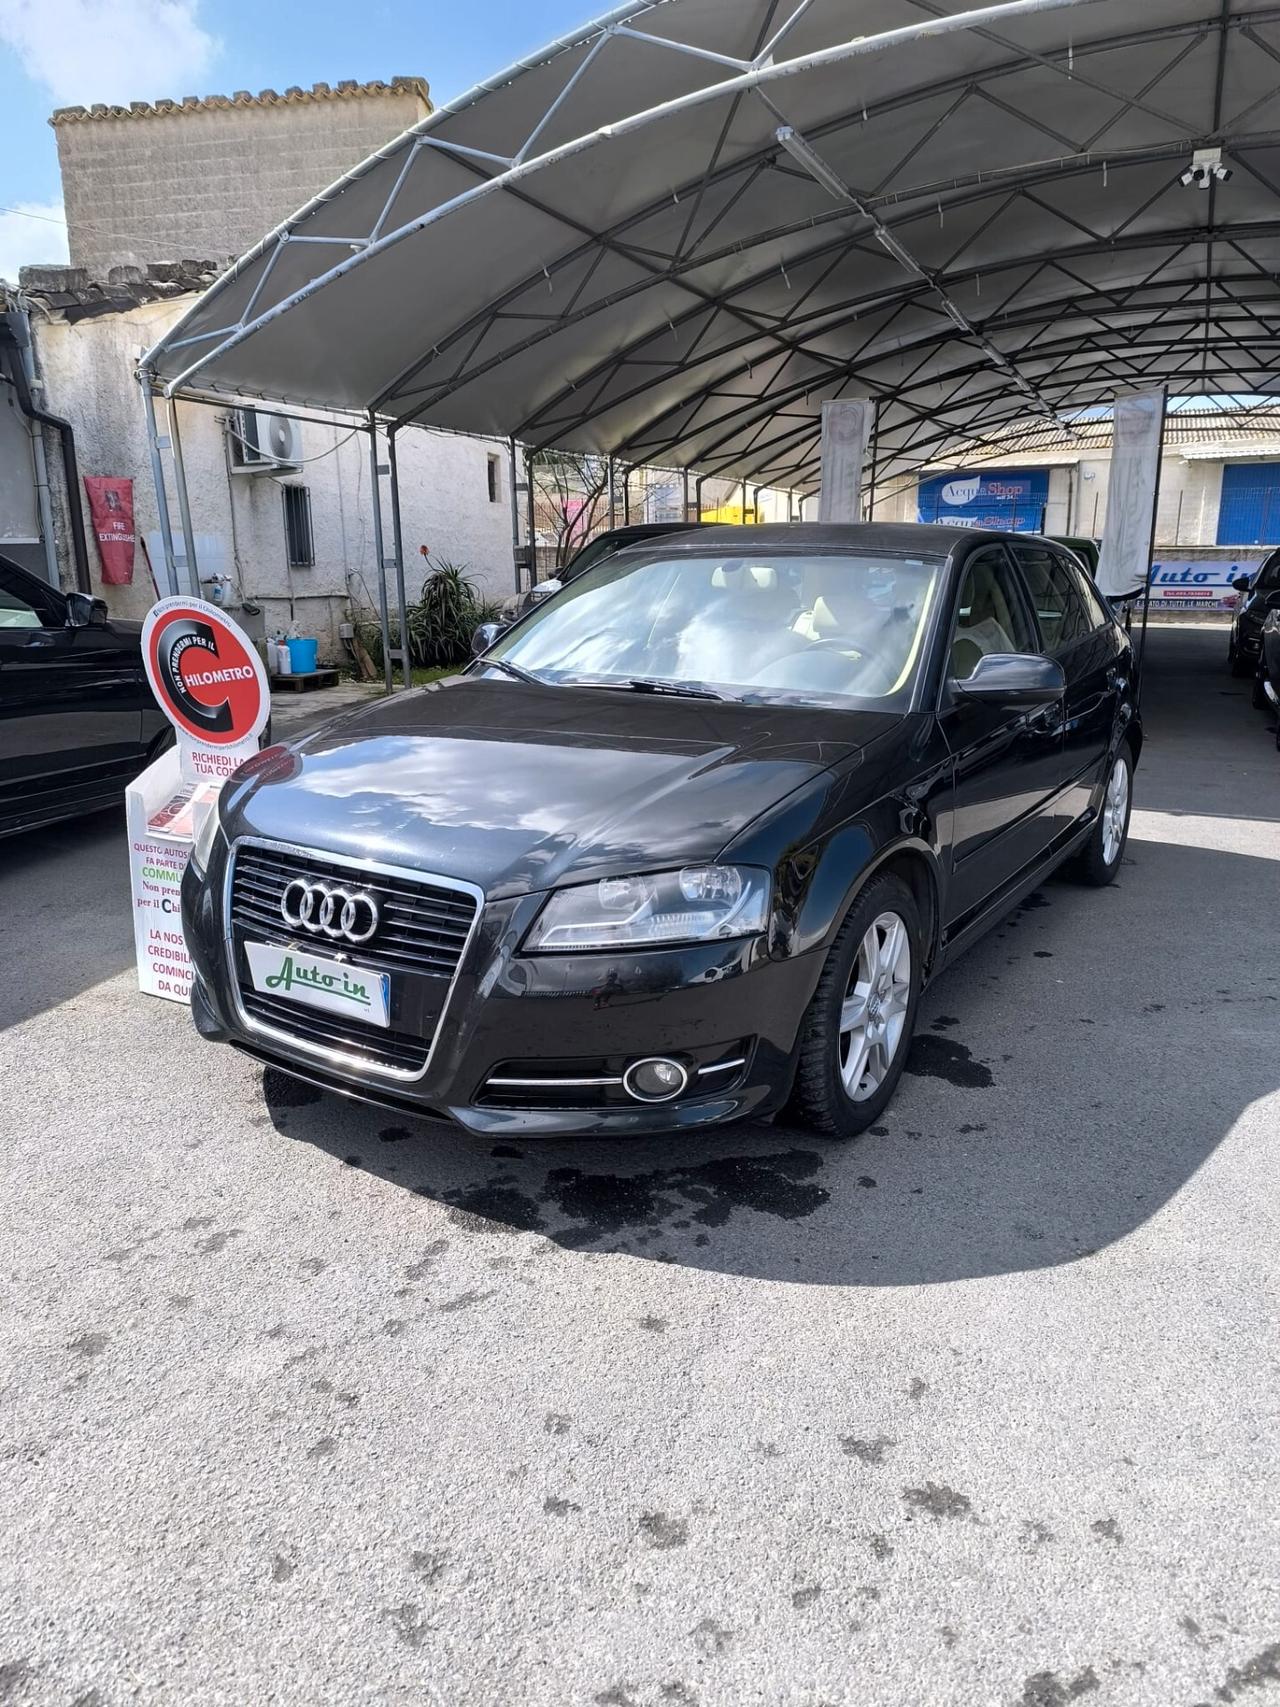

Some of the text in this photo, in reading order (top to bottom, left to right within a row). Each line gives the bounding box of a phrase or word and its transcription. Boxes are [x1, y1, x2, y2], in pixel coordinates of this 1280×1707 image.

[988, 482, 1024, 496] Shop
[1161, 601, 1169, 609] DI
[1169, 601, 1186, 609] TUTTE
[1187, 601, 1194, 609] LE
[1196, 601, 1218, 609] MARCHE
[171, 636, 216, 694] NON PRENDERMI PER IL
[192, 752, 232, 767] RICHIEDI
[195, 762, 214, 775] TUA
[133, 842, 163, 855] QUESTO
[145, 856, 155, 866] FA
[155, 858, 177, 870] PARTE
[142, 880, 160, 893] Non
[137, 898, 151, 908] per
[153, 899, 160, 909] il
[149, 928, 184, 946] LA NOS
[152, 962, 194, 981] COMINCI
[265, 956, 371, 1001] Auto in
[158, 979, 192, 997] DA QUI
